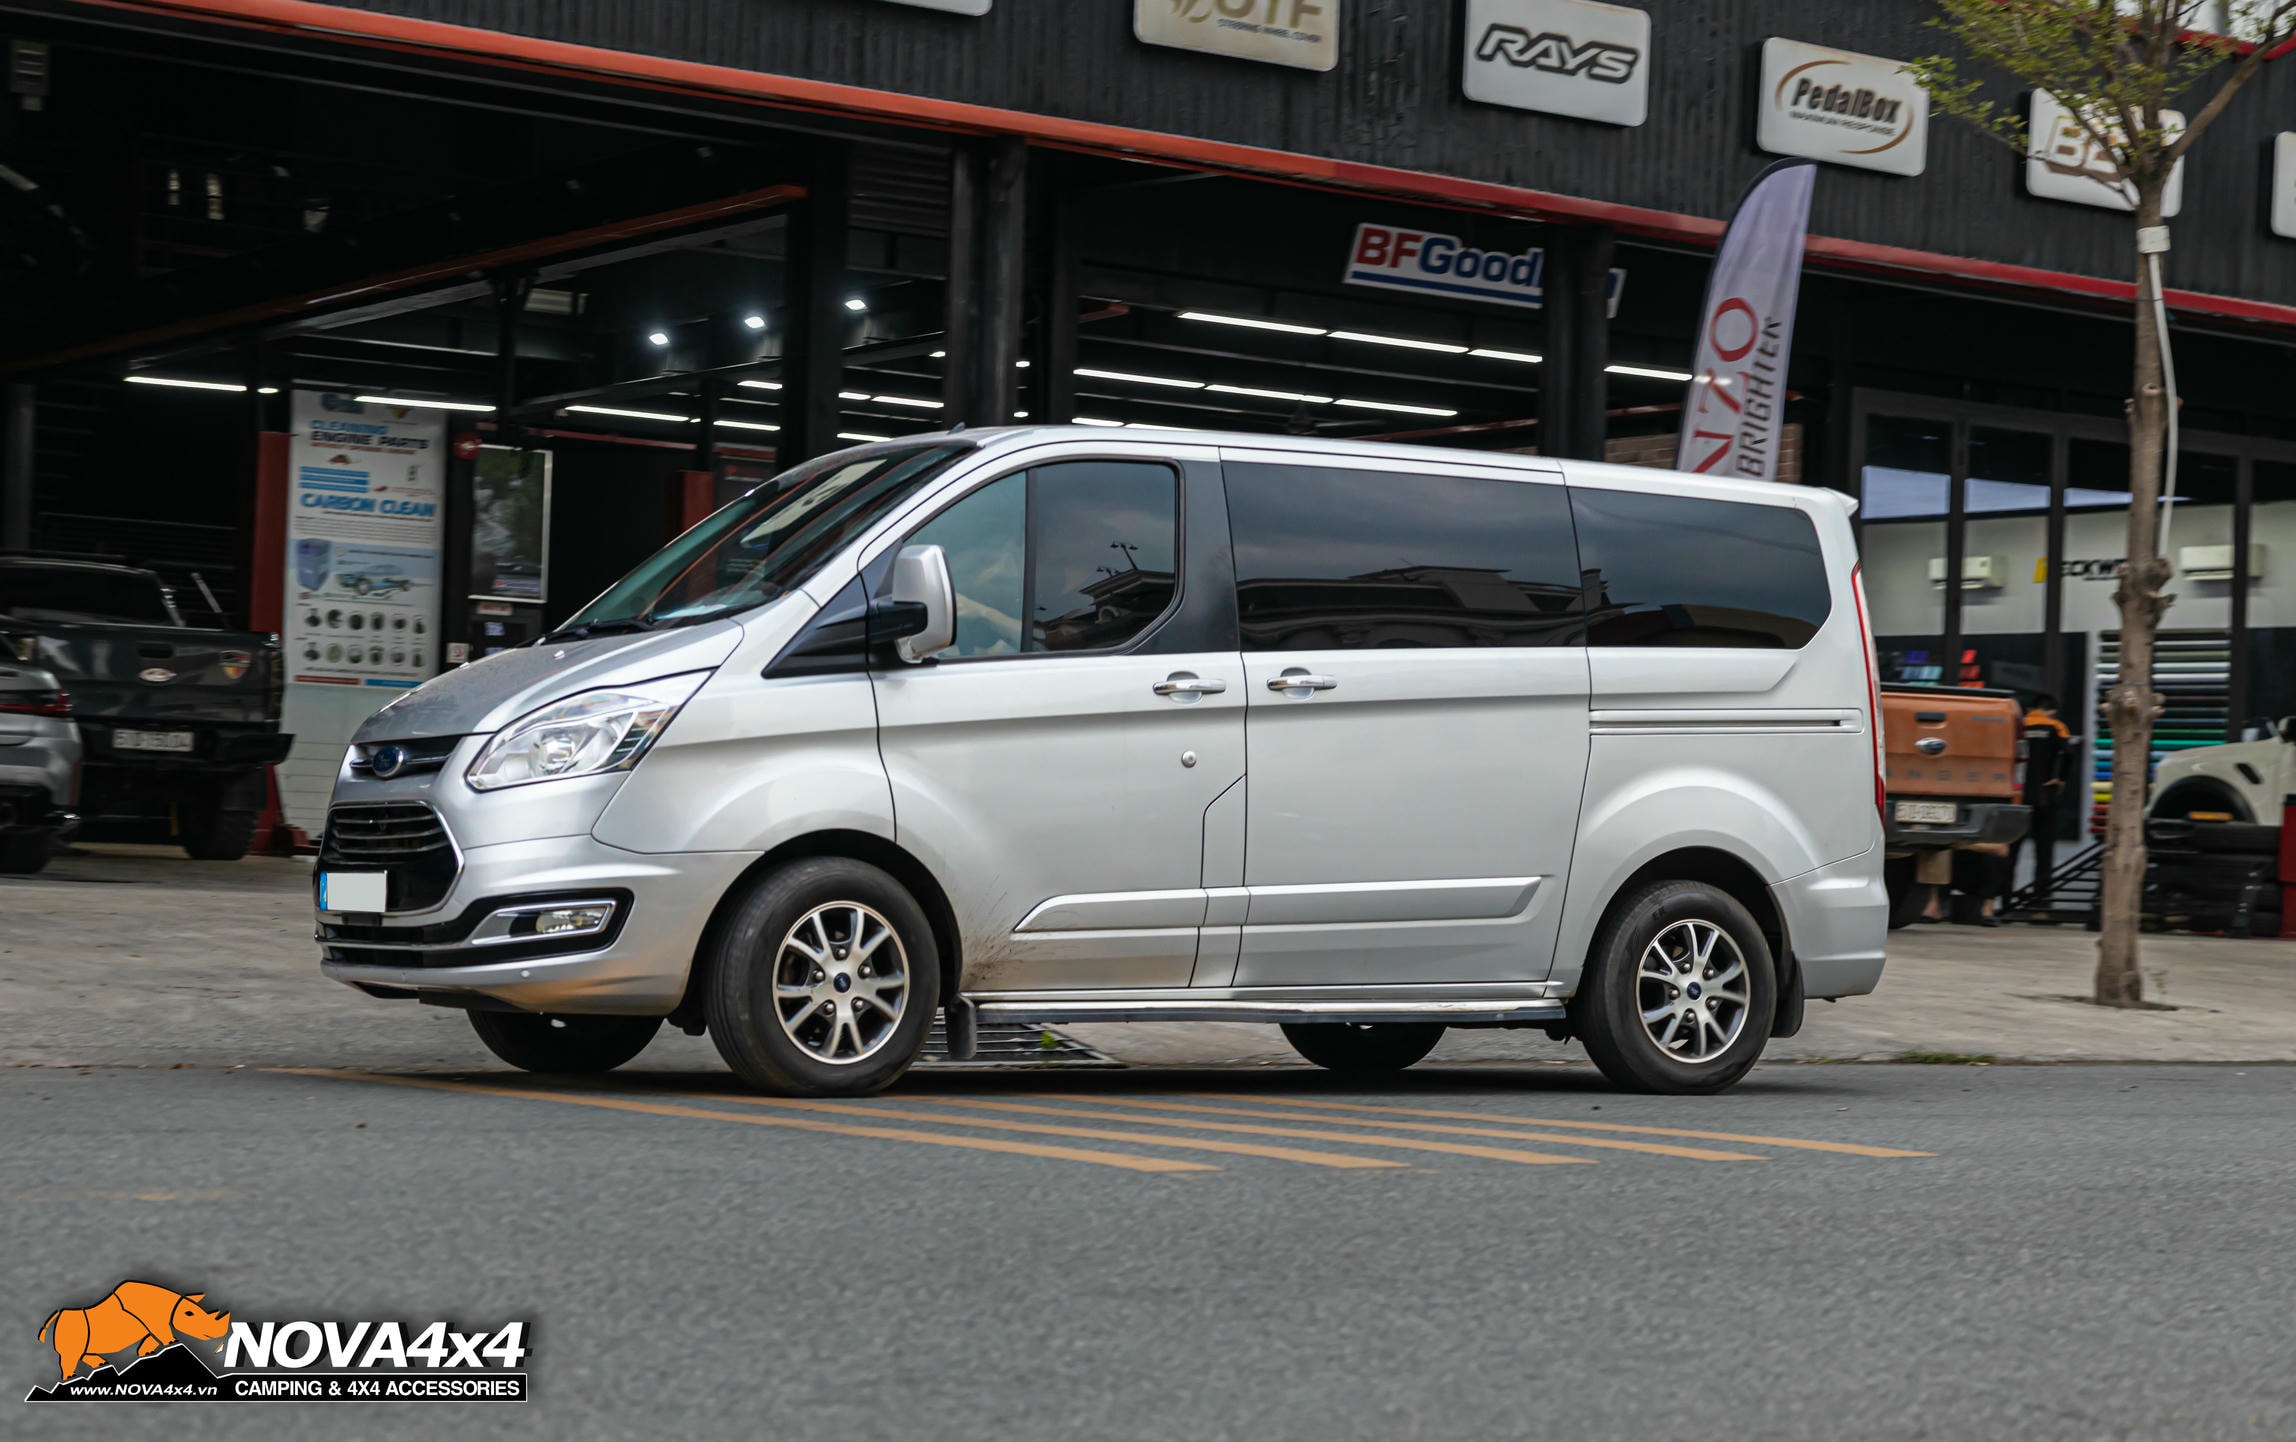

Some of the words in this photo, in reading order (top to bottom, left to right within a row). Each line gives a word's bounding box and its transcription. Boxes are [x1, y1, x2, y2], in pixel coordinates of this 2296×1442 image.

[1476, 23, 1640, 84] RAYS
[1791, 77, 1902, 124] PedalBox
[1736, 316, 1783, 478] BRIGHTER
[311, 430, 373, 445] ENGINE
[378, 436, 429, 449] PARTS
[301, 493, 377, 512] CARBON
[380, 499, 437, 517] CLEAN
